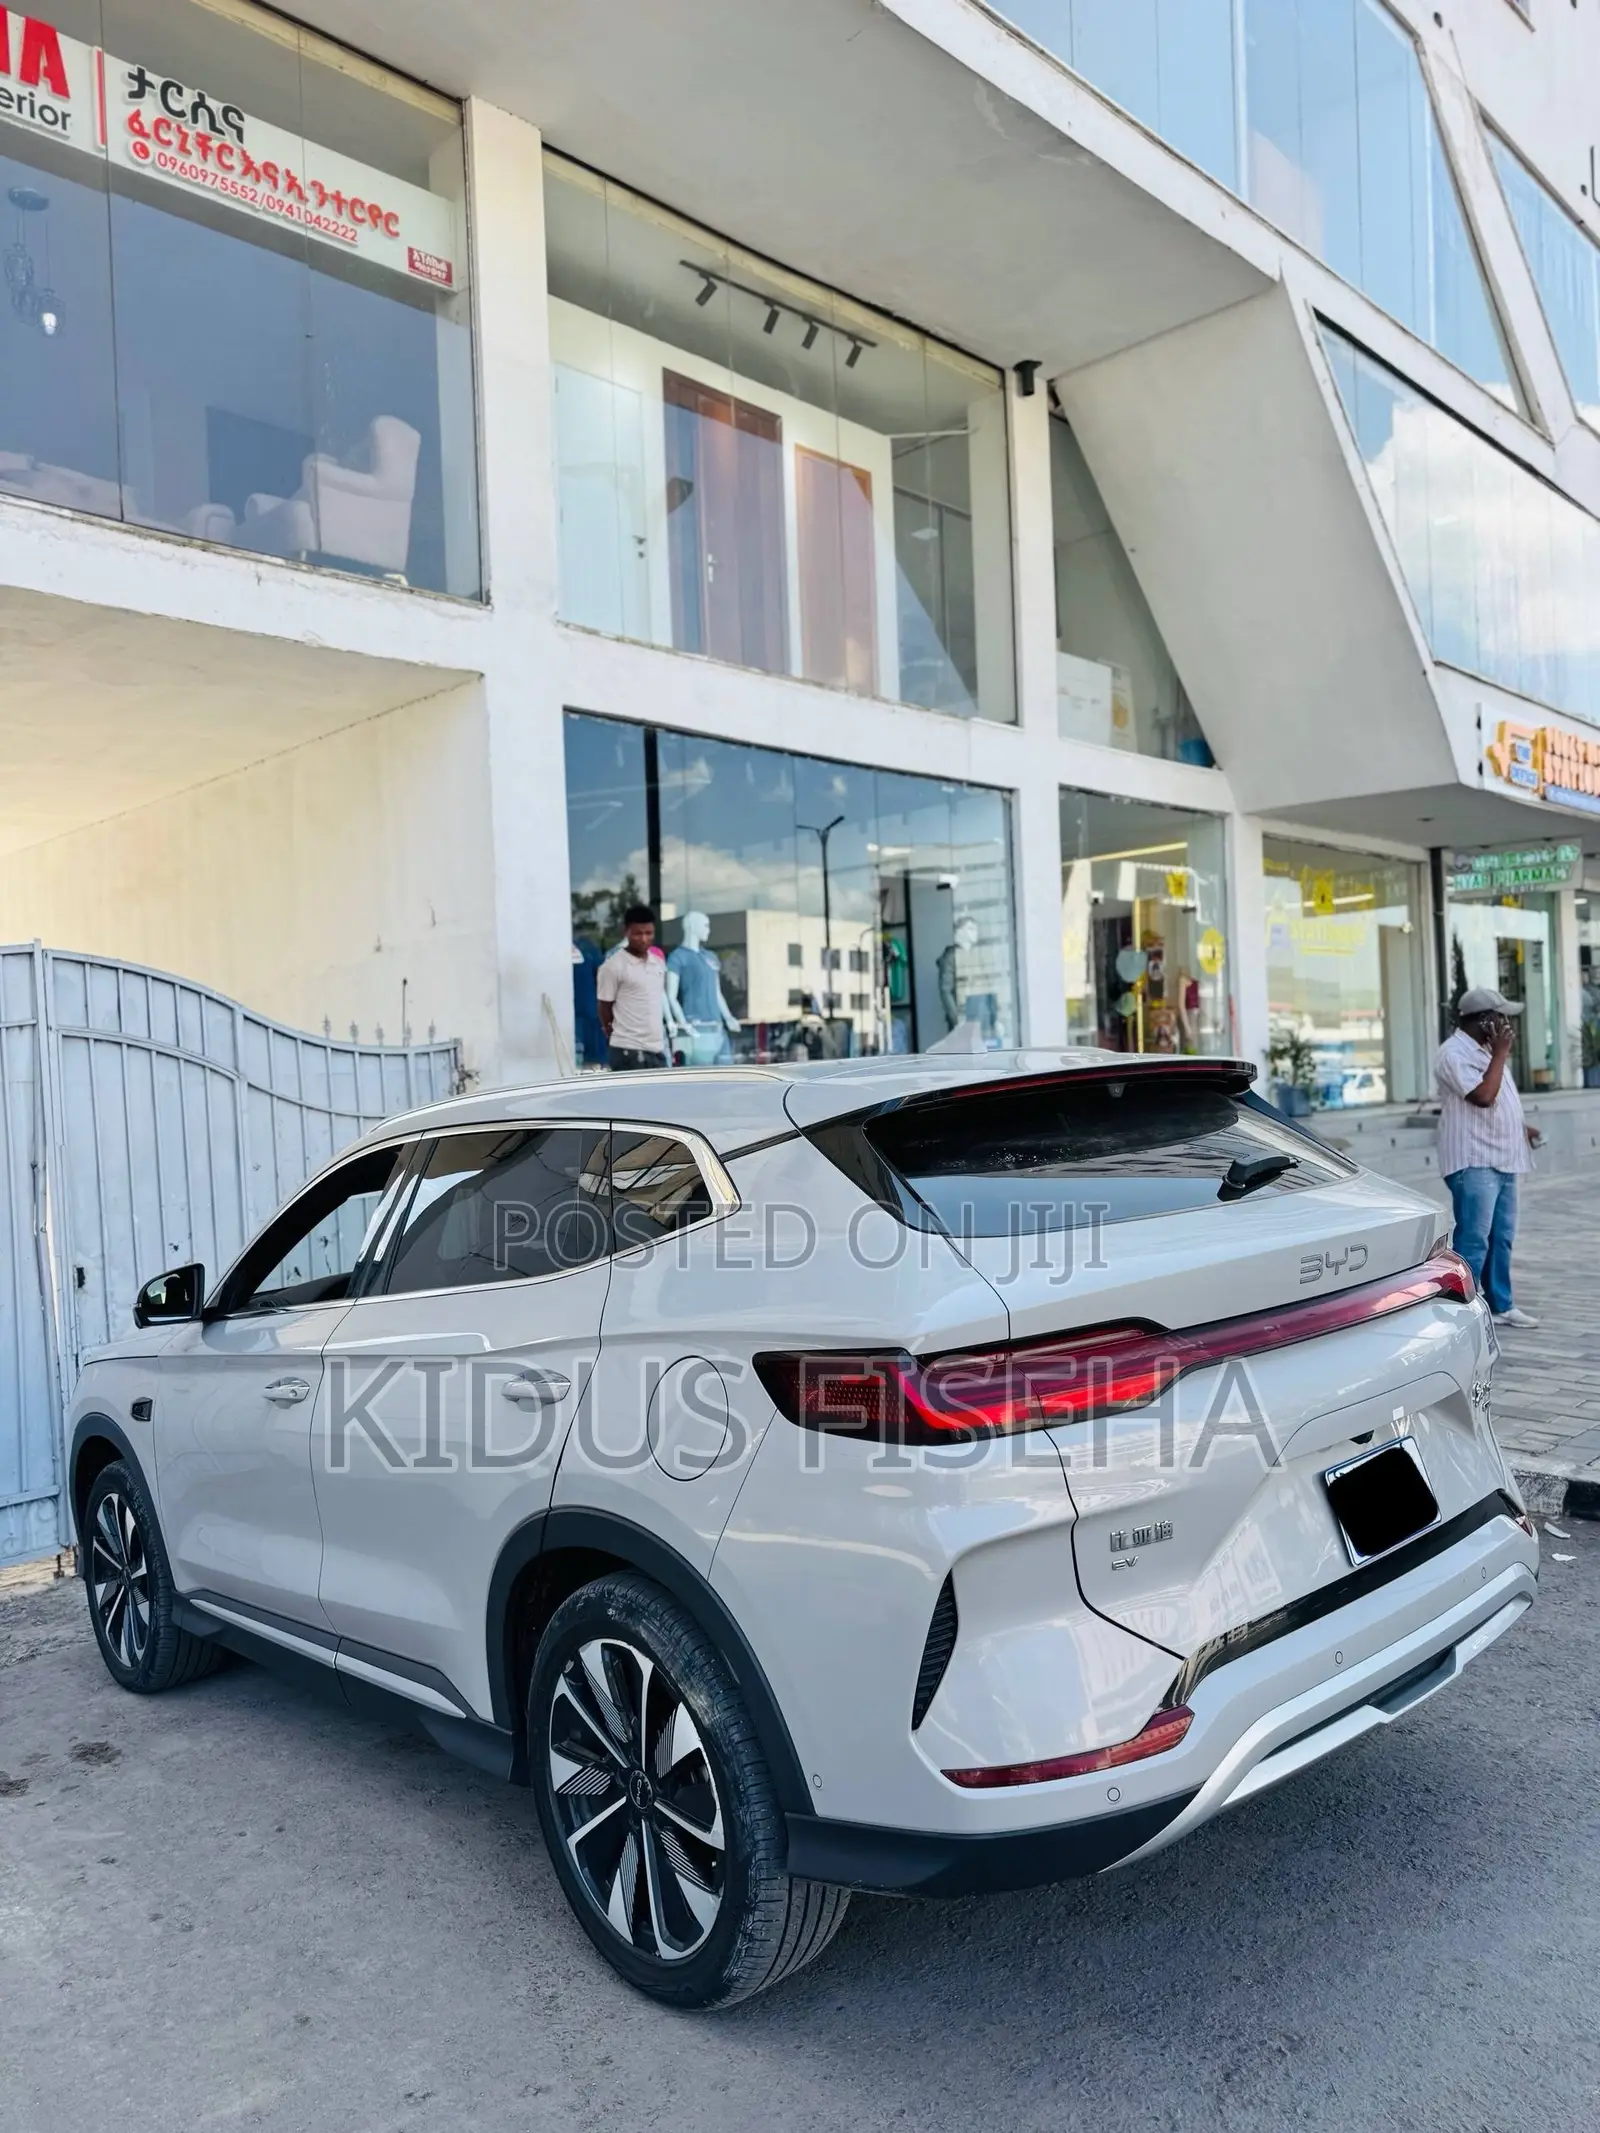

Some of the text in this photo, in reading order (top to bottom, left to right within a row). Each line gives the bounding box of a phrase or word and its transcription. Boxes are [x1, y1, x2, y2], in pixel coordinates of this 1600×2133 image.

[156, 151, 359, 243] 0960975552/0941042222
[1299, 1243, 1368, 1285] BYD
[1111, 1556, 1140, 1571] EV
